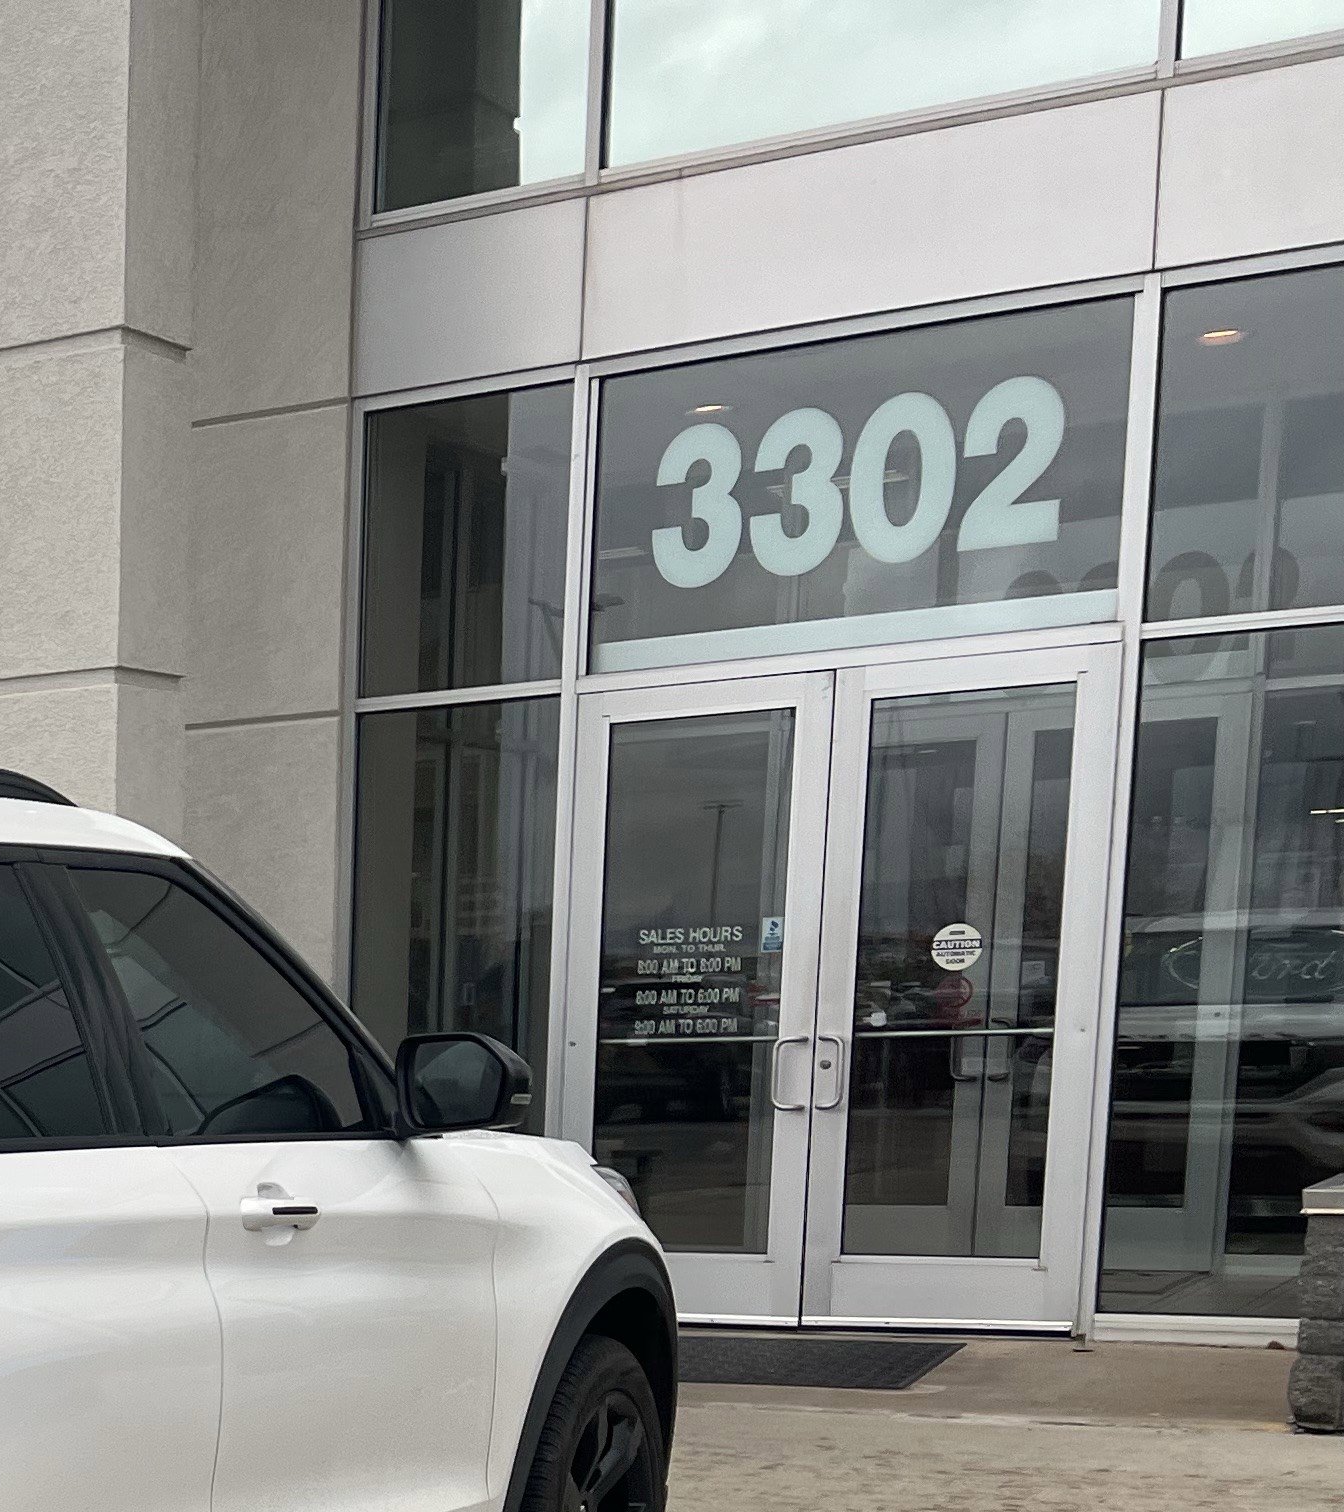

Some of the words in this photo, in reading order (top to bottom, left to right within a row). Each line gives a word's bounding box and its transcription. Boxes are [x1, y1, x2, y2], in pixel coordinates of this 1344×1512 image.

[652, 376, 1065, 588] 3302
[639, 927, 684, 944] SALES
[689, 926, 743, 943] HOURS
[683, 944, 695, 952] TO
[932, 940, 981, 949] CAUTION
[637, 959, 659, 974] 8:00
[661, 959, 679, 974] AM
[682, 958, 696, 973] TO
[724, 957, 742, 972] PM
[671, 974, 704, 983] FRIDAY
[636, 990, 658, 1005] 8:00
[660, 989, 677, 1004] AM
[680, 989, 695, 1003] TO
[698, 988, 720, 1003] 6:00
[722, 987, 739, 1002] PM
[663, 1005, 710, 1014] SATURDAY
[658, 1019, 675, 1034] AM
[679, 1019, 693, 1033] TO
[696, 1019, 718, 1033] 6:00
[721, 1018, 738, 1033] PM
